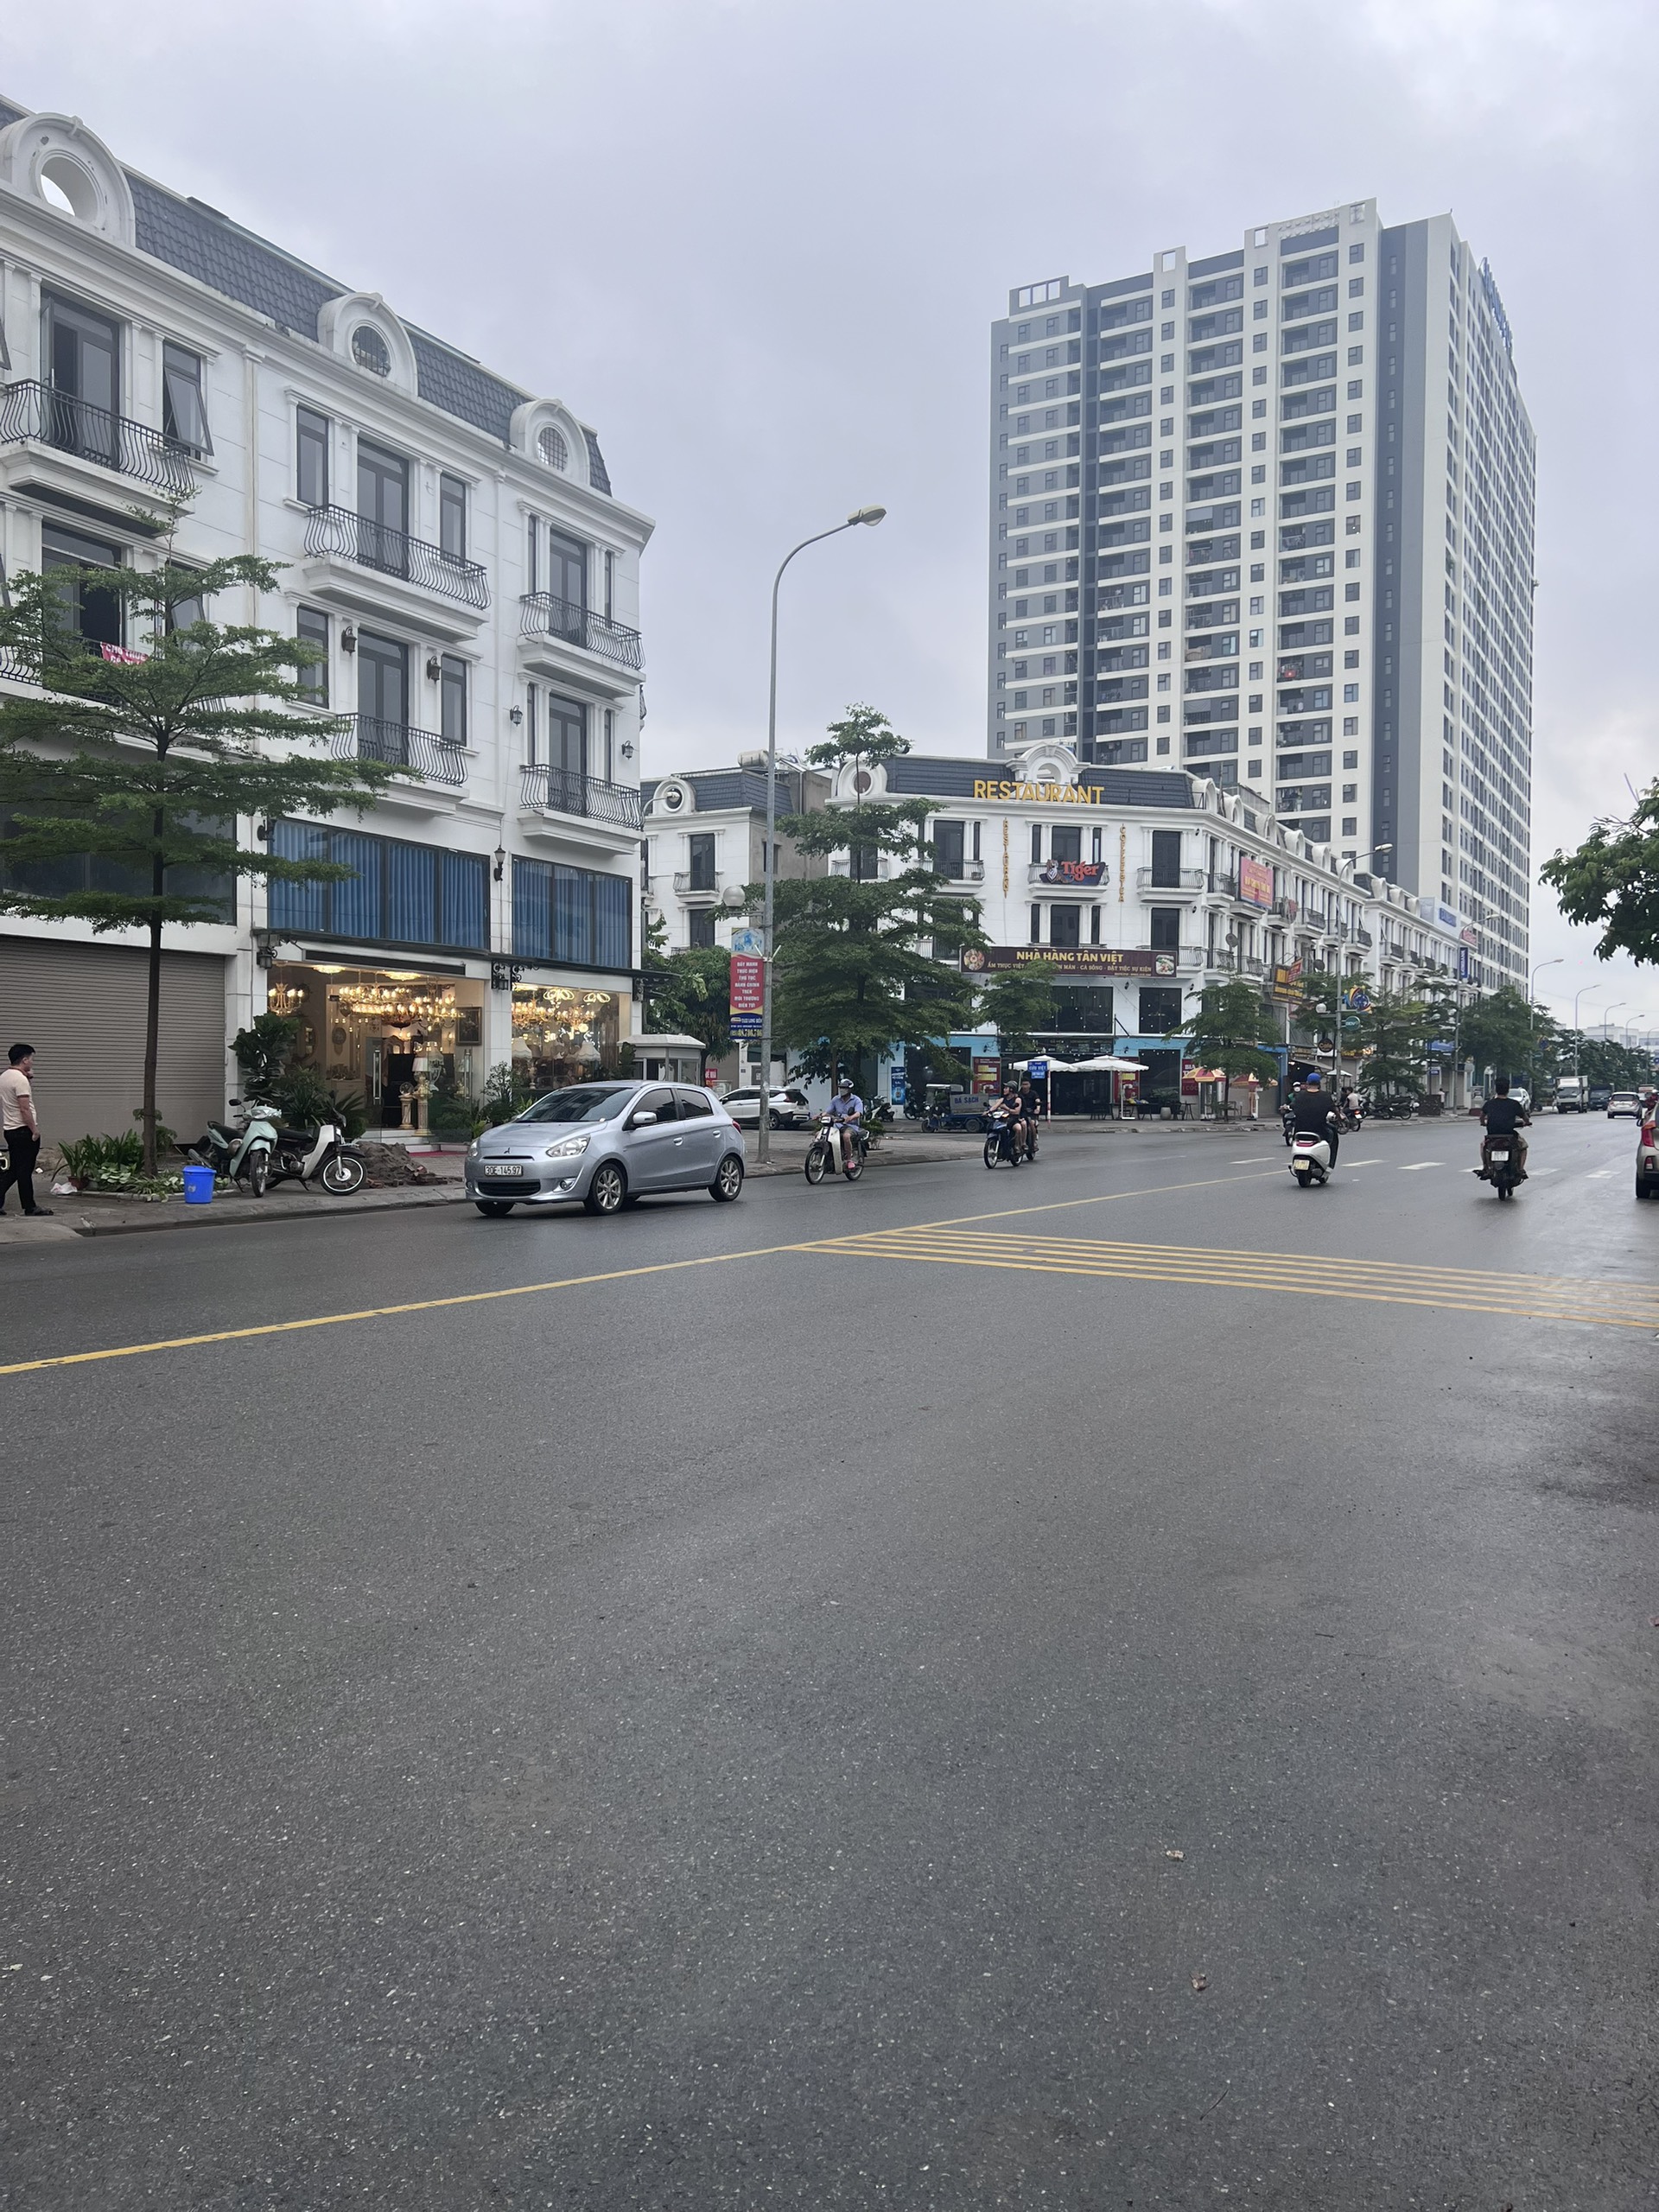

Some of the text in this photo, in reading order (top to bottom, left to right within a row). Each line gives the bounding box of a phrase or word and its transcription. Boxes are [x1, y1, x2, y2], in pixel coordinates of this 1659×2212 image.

[105, 643, 123, 655] CHO
[974, 779, 1104, 804] RESTAURANT
[1061, 861, 1099, 881] Tiger
[1016, 949, 1123, 965] NHÀ HÀNG TÂN VIỆT
